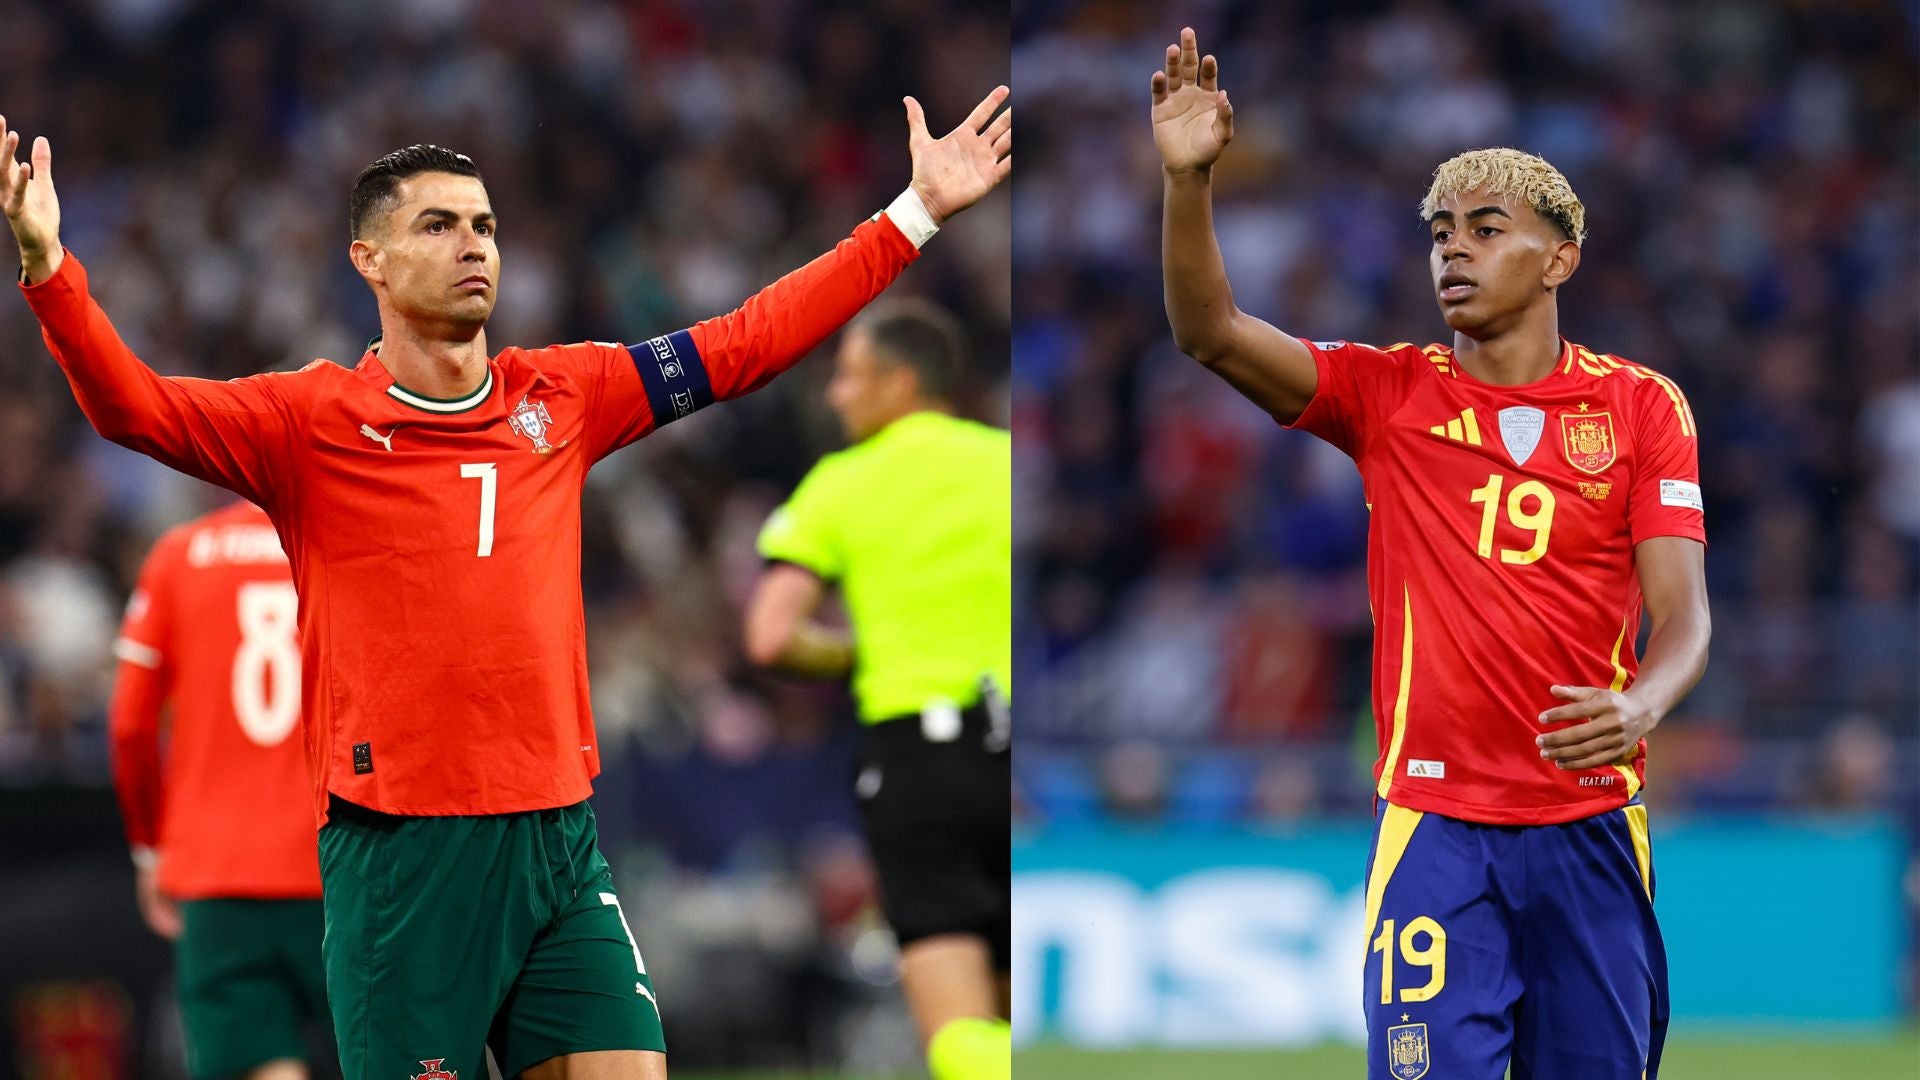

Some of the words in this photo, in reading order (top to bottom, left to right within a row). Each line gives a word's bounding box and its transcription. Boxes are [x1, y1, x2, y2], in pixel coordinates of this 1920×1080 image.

[654, 337, 673, 360] RES
[460, 462, 498, 558] 7
[1470, 473, 1556, 565] 19
[231, 579, 302, 746] 8
[1579, 776, 1615, 787] HEAT.RDY
[598, 892, 647, 975] 7
[1373, 915, 1447, 1005] 19
